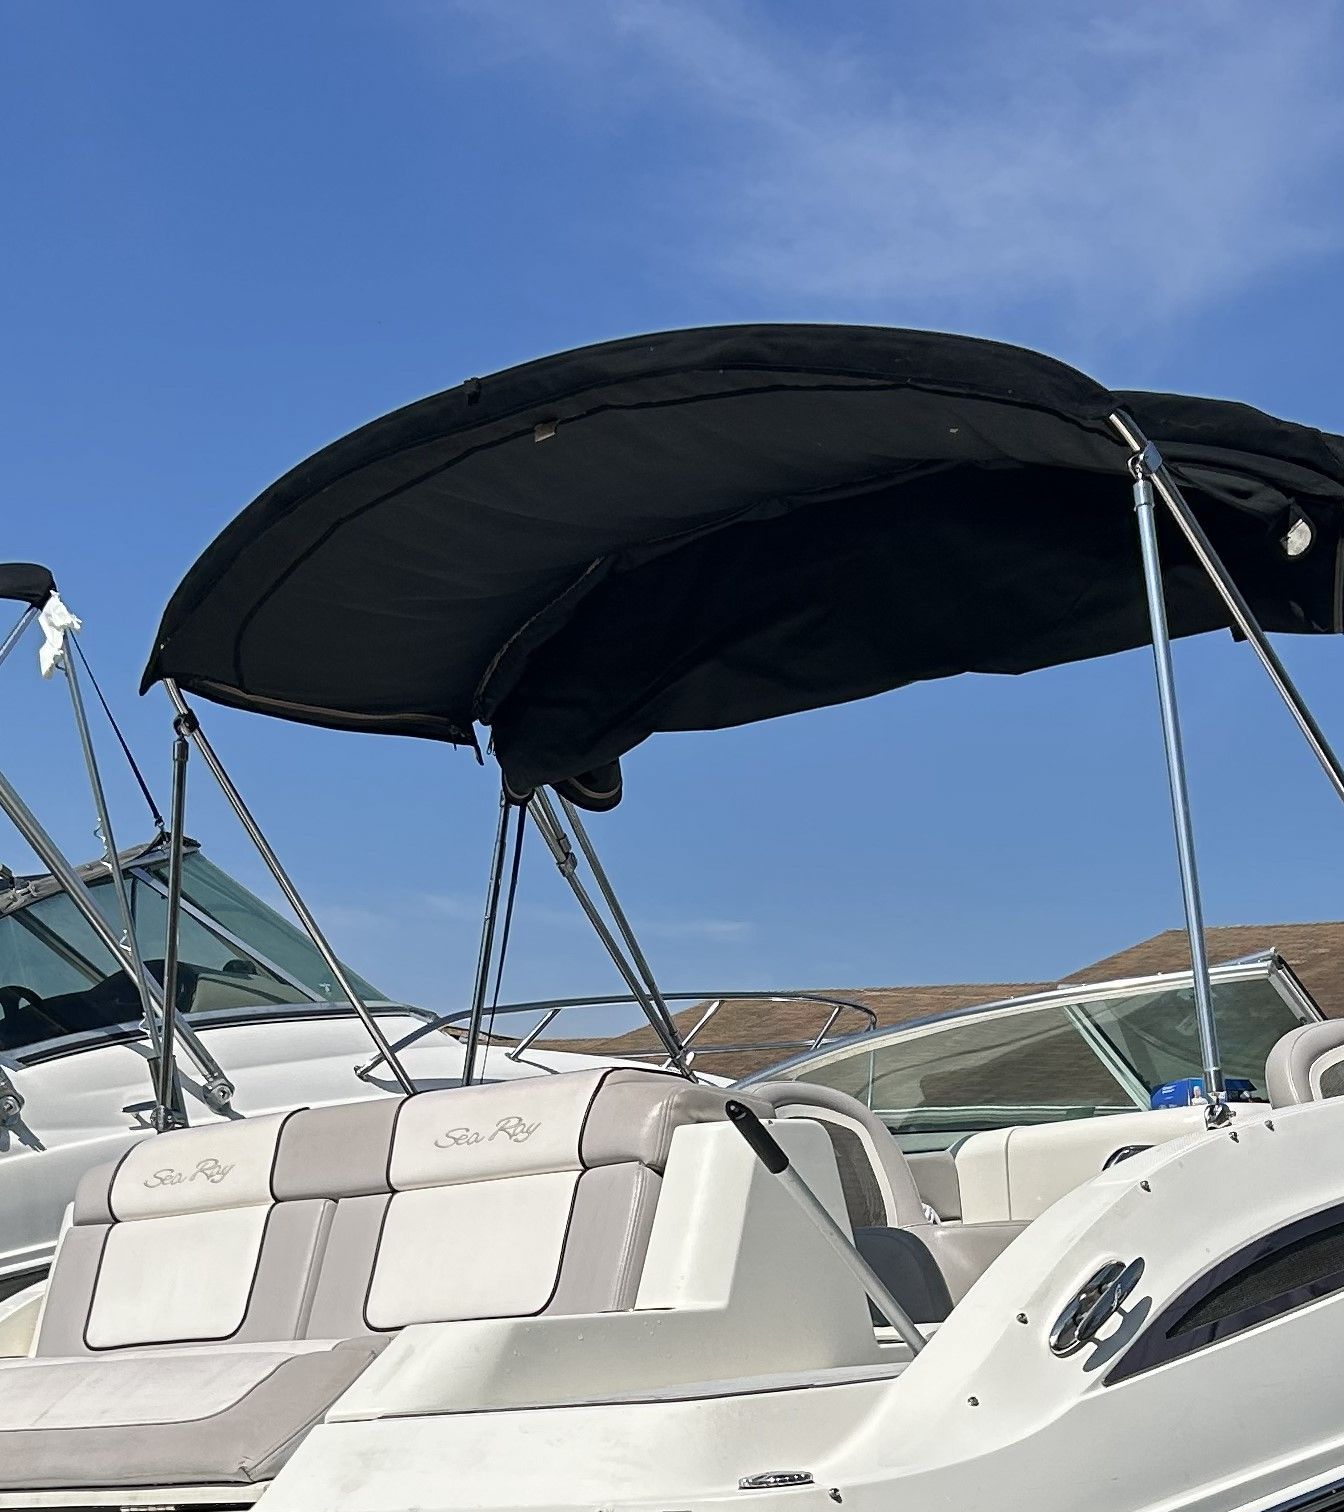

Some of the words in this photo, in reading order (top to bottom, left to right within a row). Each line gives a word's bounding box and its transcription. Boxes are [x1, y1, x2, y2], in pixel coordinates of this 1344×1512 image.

[434, 1128, 485, 1148] Sea
[488, 1116, 541, 1142] Ray
[144, 1169, 187, 1188] Sea
[188, 1158, 235, 1183] Ray
